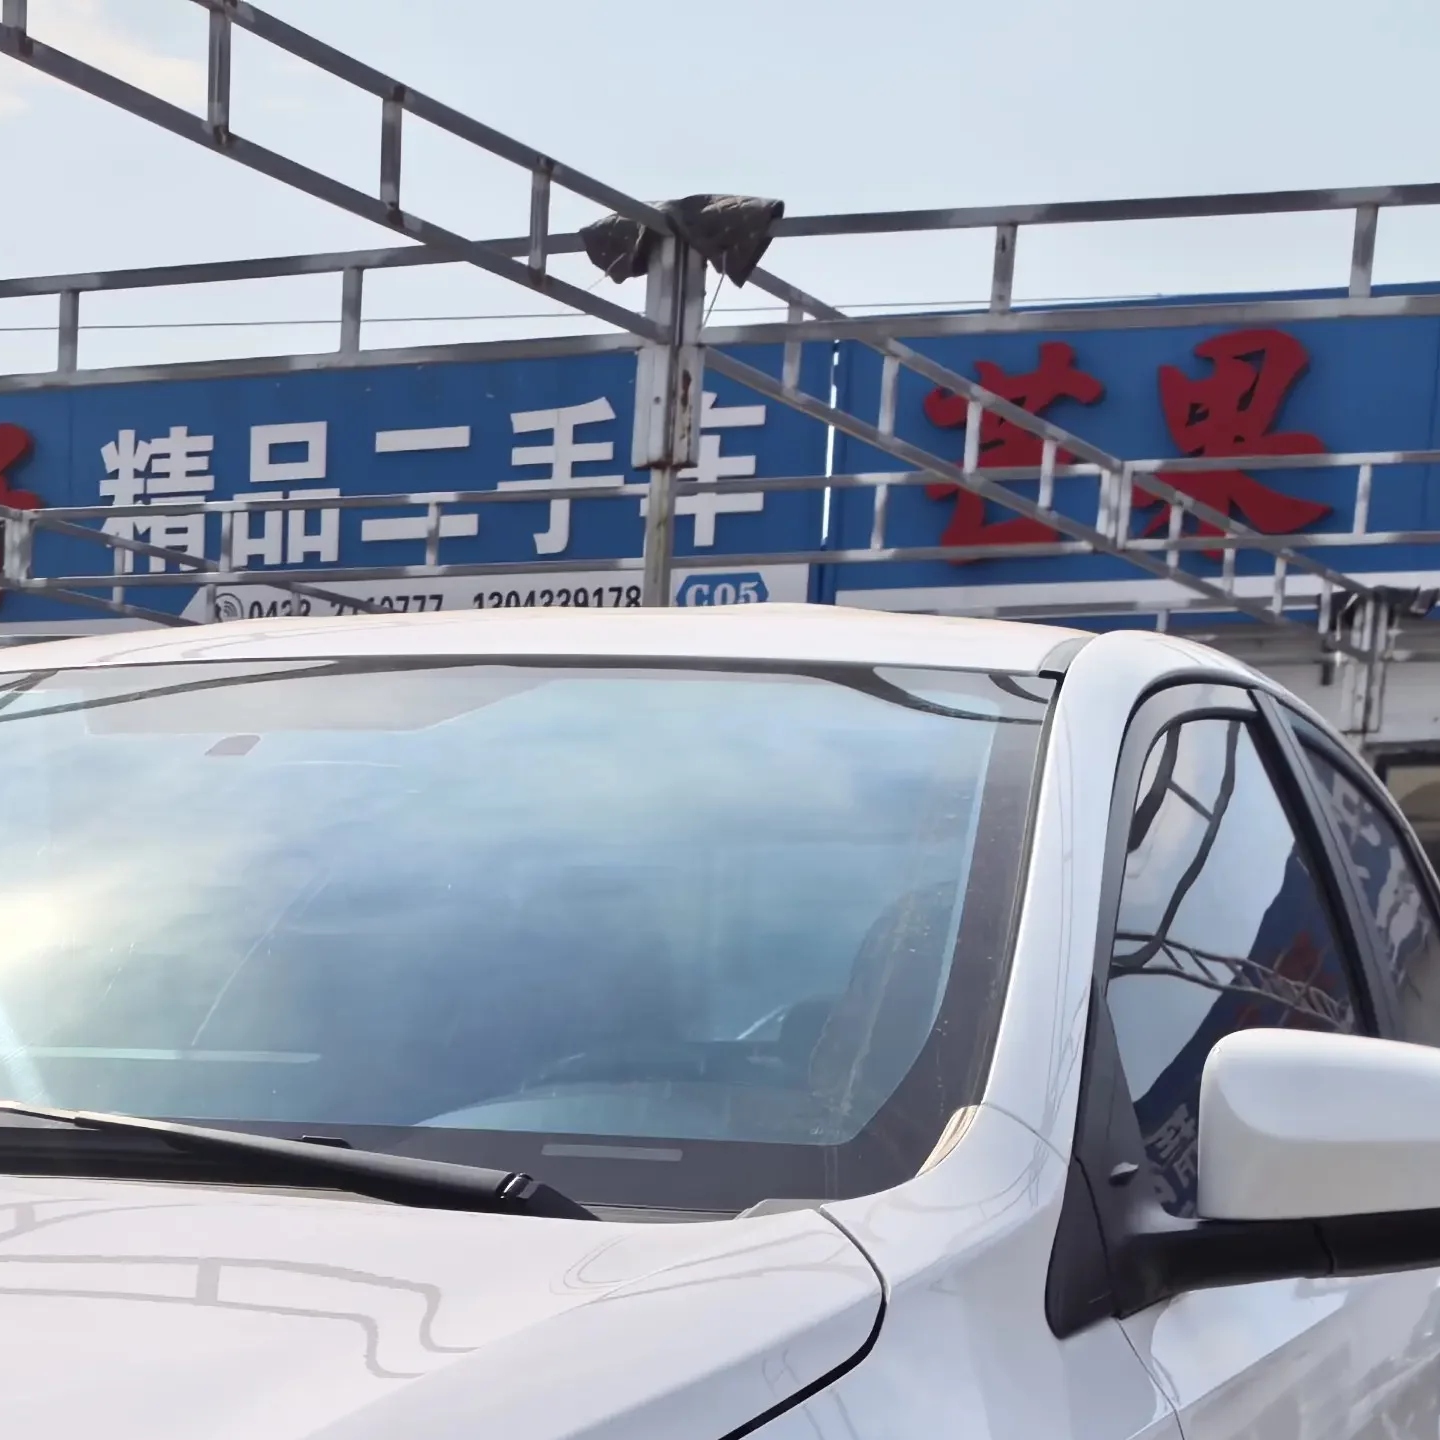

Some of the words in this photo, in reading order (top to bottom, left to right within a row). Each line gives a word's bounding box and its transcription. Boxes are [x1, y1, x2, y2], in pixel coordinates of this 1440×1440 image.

[99, 391, 766, 574] 精品二手车
[685, 581, 759, 606] C05
